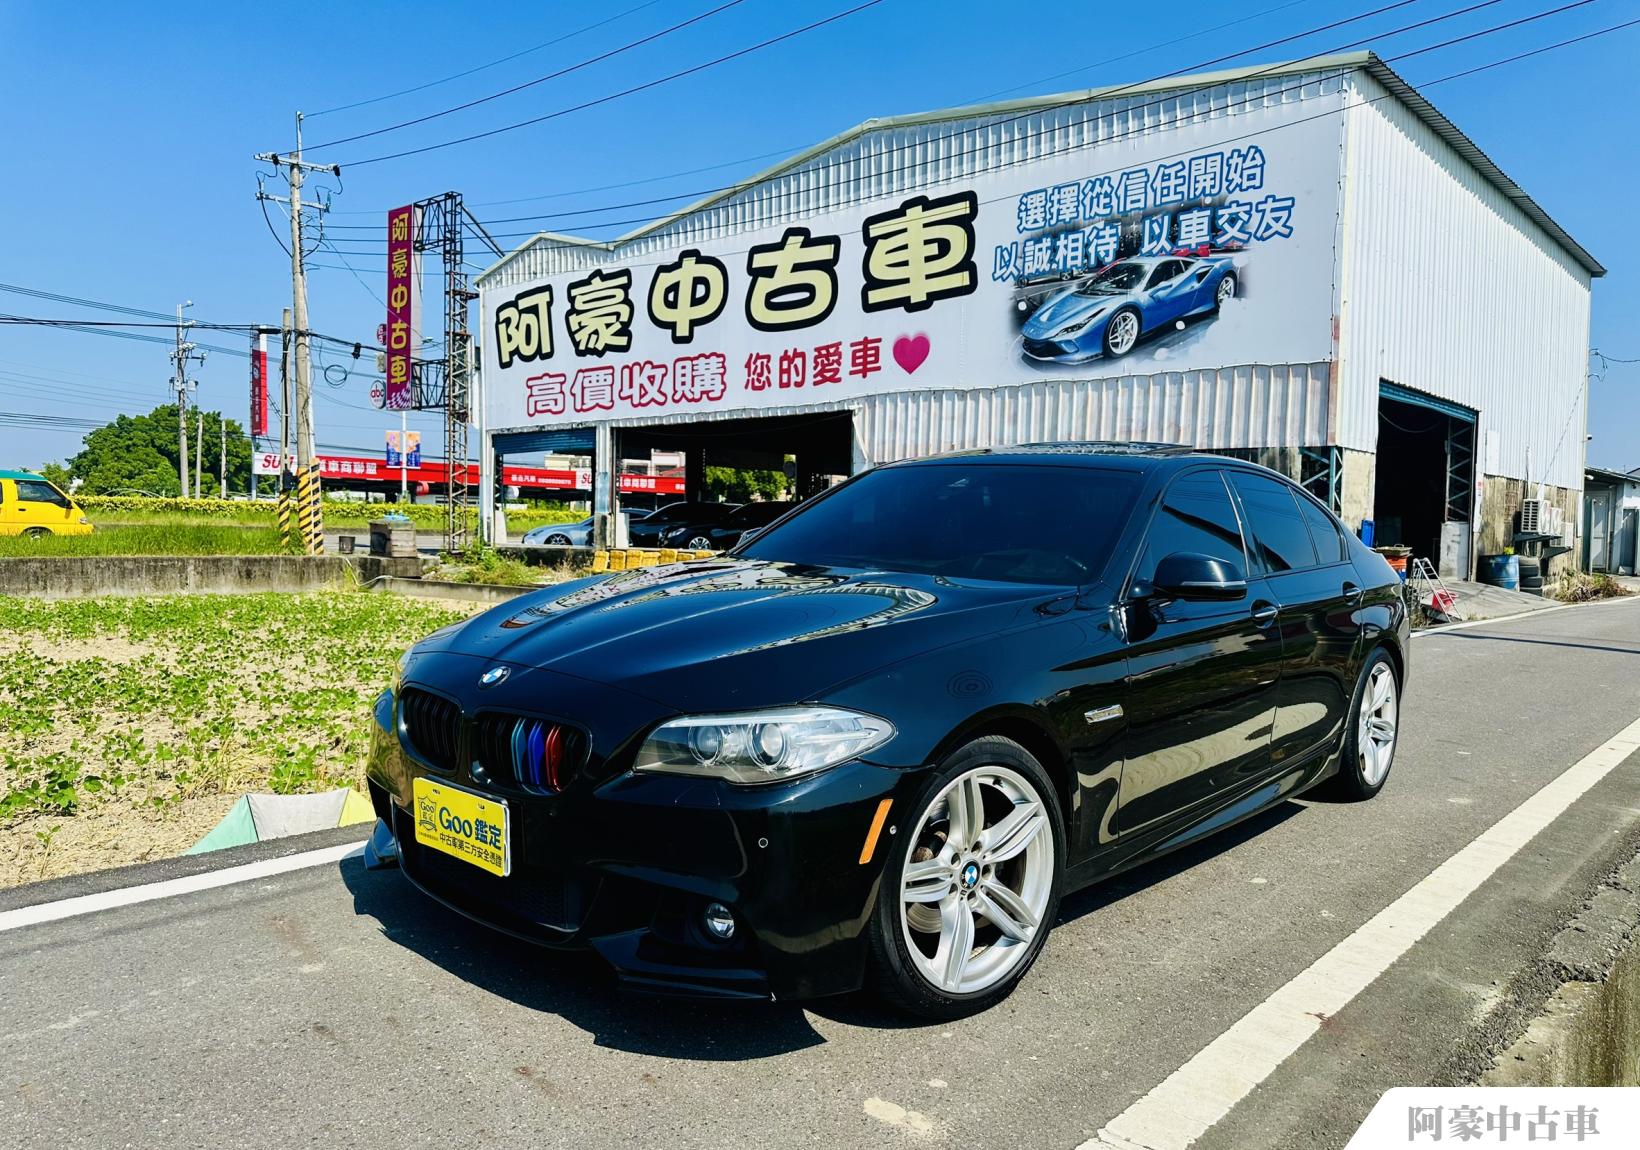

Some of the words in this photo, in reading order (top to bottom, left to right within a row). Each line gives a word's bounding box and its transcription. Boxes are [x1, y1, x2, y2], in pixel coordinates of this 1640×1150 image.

[1017, 145, 1265, 233] 選擇從信任開始
[495, 190, 977, 369] 阿豪中古車
[992, 221, 1121, 284] 以誠相待
[1139, 194, 1296, 257] 以車交友
[391, 212, 409, 385] 阿豪中古車
[526, 351, 727, 417] 高價收購
[744, 336, 883, 391] 您的愛車
[475, 817, 502, 851] 鑑定
